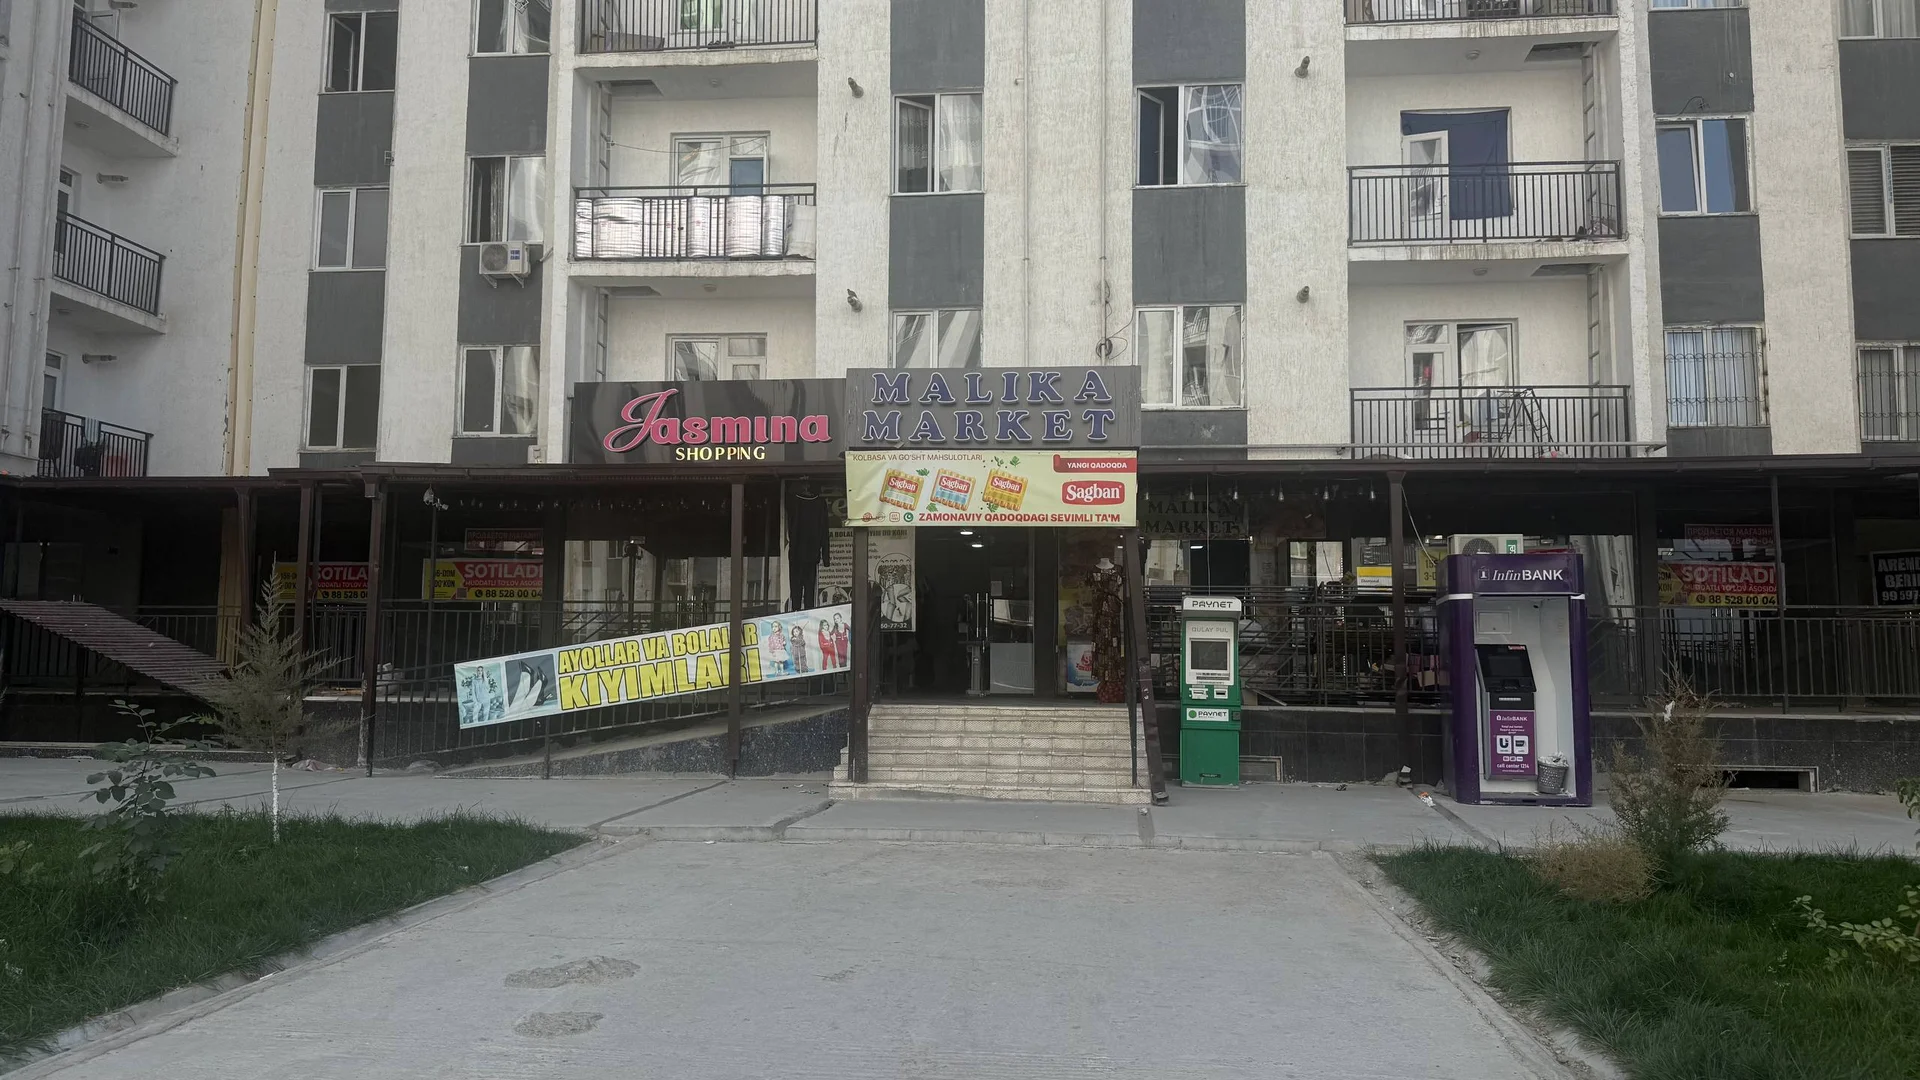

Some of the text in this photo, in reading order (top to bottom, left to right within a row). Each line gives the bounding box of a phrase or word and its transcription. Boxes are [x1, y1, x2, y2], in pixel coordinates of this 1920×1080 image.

[871, 370, 1113, 404] MALIKA
[861, 409, 1116, 443] MARKET
[675, 446, 766, 462] SHOPPING
[853, 454, 887, 462] KOLBASA
[927, 453, 983, 462] MAHSULOTLARI
[889, 477, 919, 491] Sagban
[940, 477, 970, 491] Sagban
[992, 477, 1021, 491] Sagban
[1066, 483, 1121, 502] Sagban
[1148, 501, 1232, 514] MALIKA
[919, 513, 1121, 523] ZAMONAVIY QADOQDAGI SEVIMLI TA'M
[1144, 520, 1236, 534] MARKET
[317, 566, 369, 581] OTILA
[463, 563, 544, 578] SOTILADI
[1682, 565, 1776, 584] SOTILADI
[331, 590, 343, 598] 88
[344, 590, 358, 598] 528
[486, 590, 494, 598] 88
[499, 590, 515, 598] 528
[517, 590, 529, 598] 00
[1724, 596, 1743, 604] 528
[1746, 596, 1758, 604] 00
[1762, 596, 1776, 605] 04
[1882, 590, 1898, 601] 99
[1192, 600, 1234, 608] PAYNET
[558, 639, 641, 675] AYOLLAR
[640, 635, 671, 661] VA
